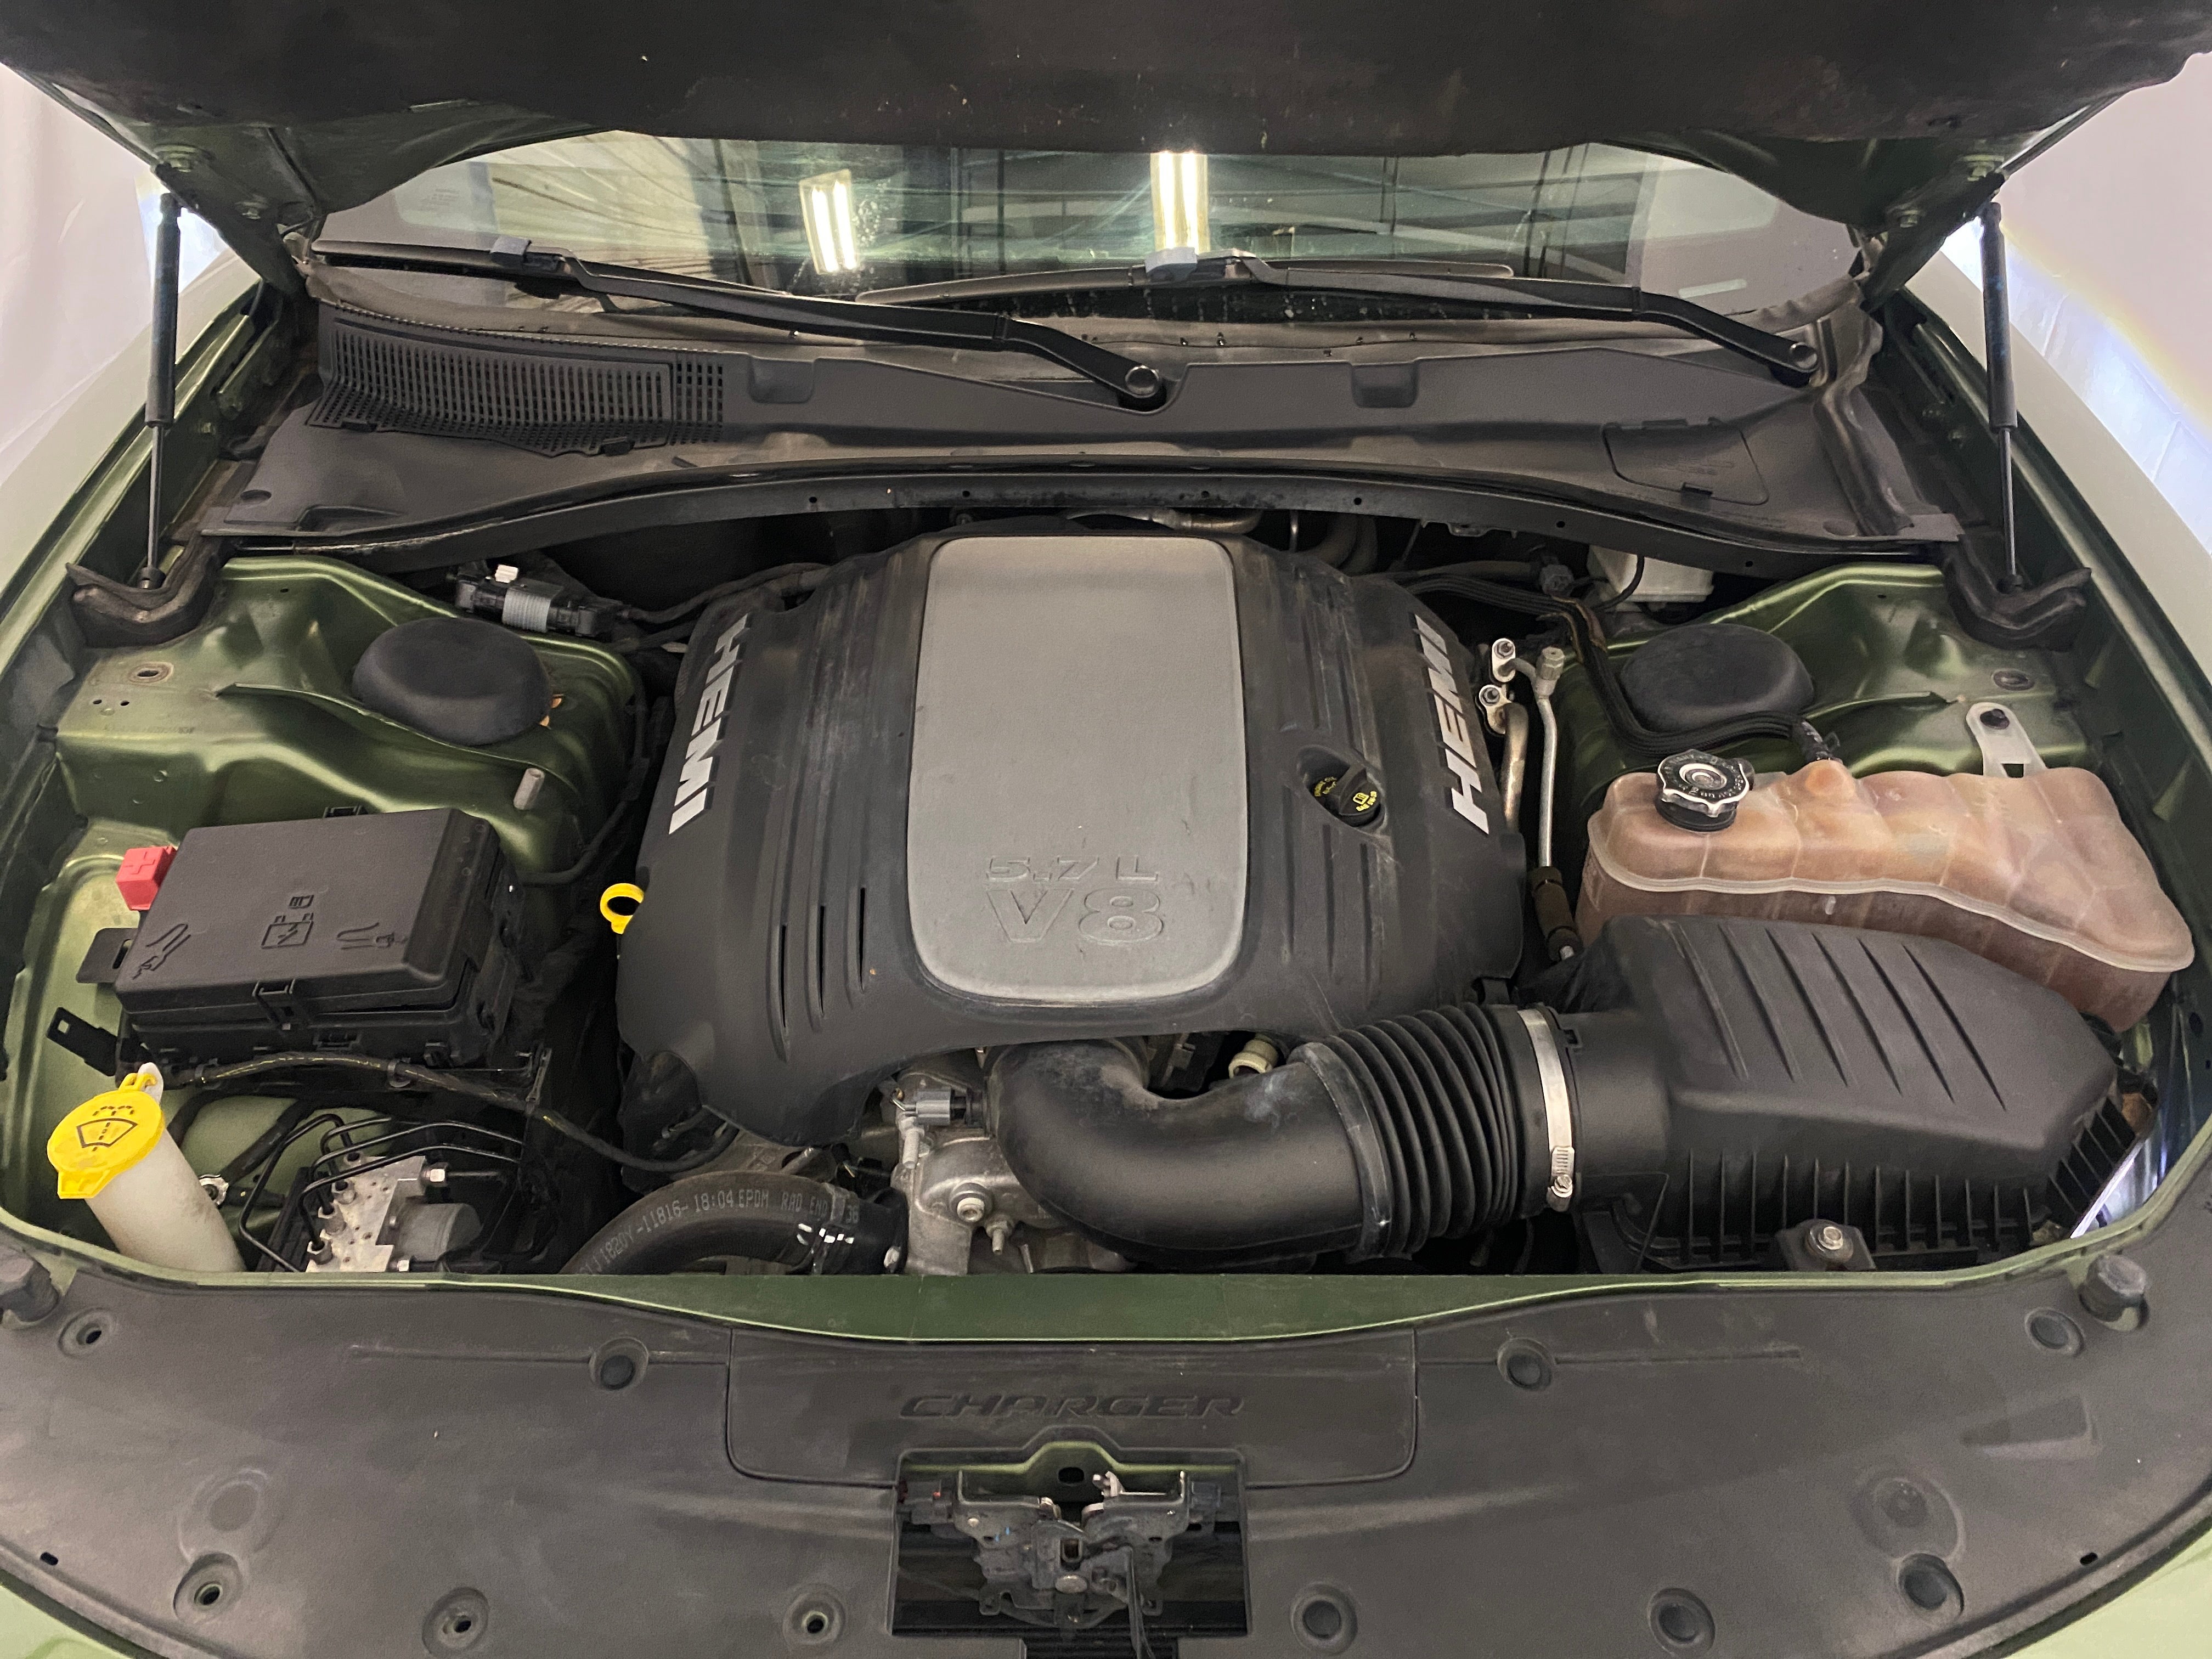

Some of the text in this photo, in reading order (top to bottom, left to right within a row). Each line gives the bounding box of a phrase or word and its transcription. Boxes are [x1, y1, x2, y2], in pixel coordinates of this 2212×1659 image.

[668, 613, 749, 835] HEMI
[1414, 613, 1489, 834] HEMI
[986, 887, 1164, 945] V8
[900, 1395, 1245, 1419] CHARGER
